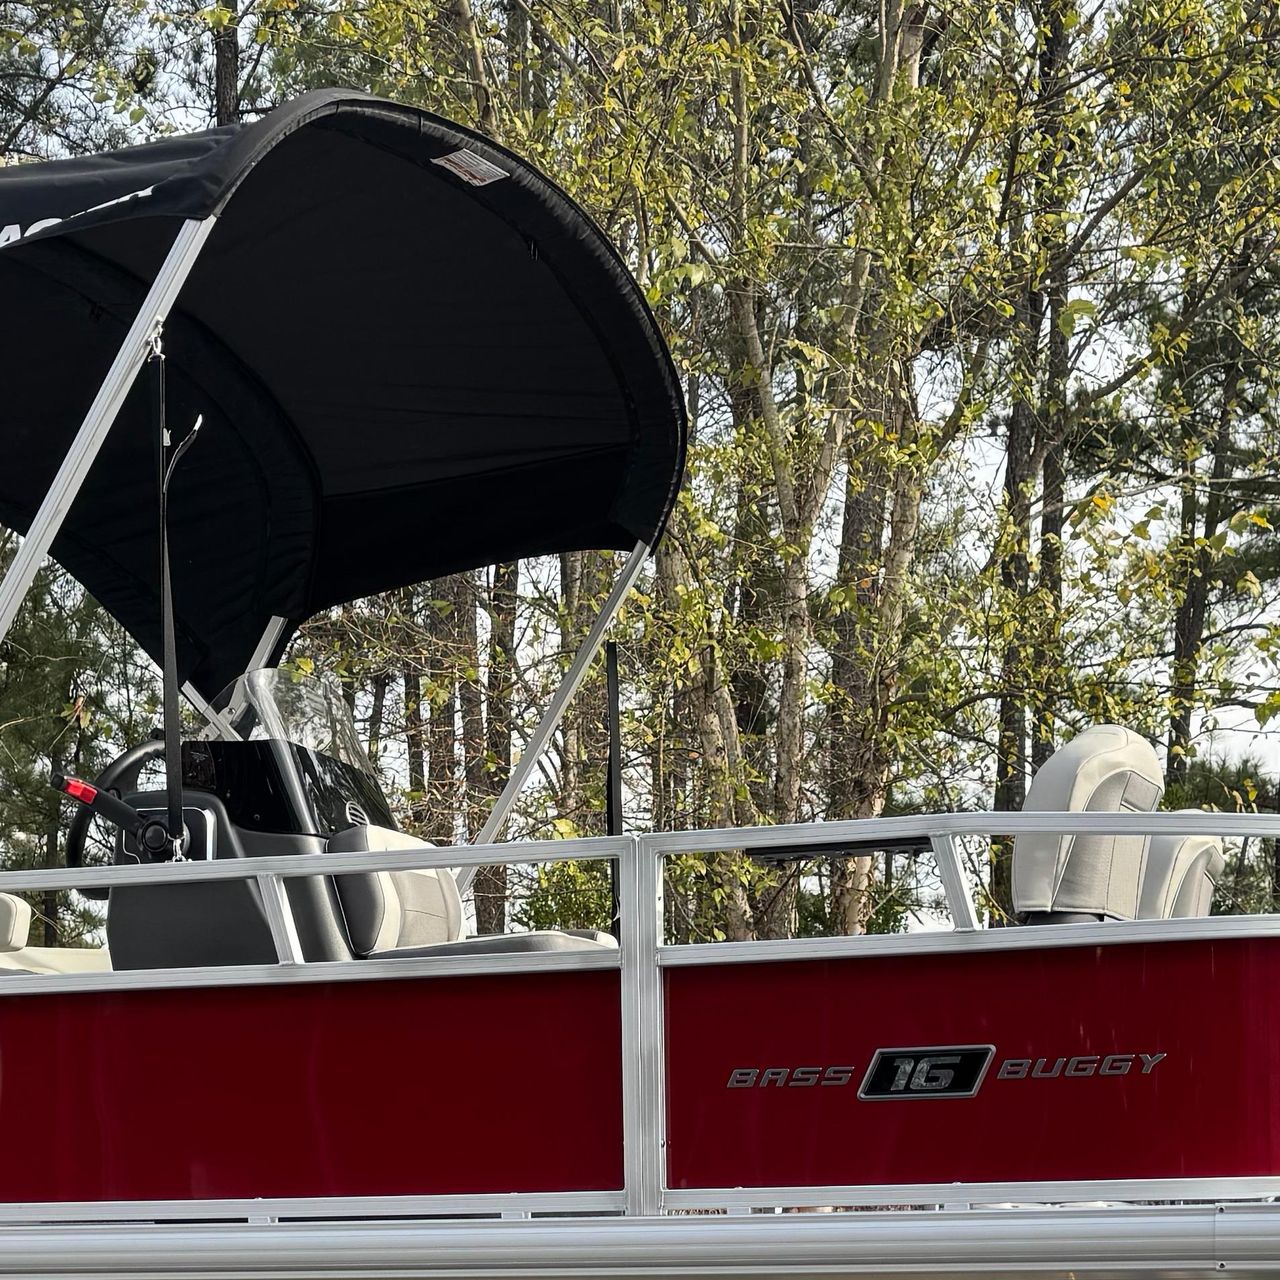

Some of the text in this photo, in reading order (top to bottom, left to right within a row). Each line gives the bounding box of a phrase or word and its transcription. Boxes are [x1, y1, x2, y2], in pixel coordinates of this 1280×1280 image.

[727, 1052, 1167, 1091] BASS 16 BUGGY
